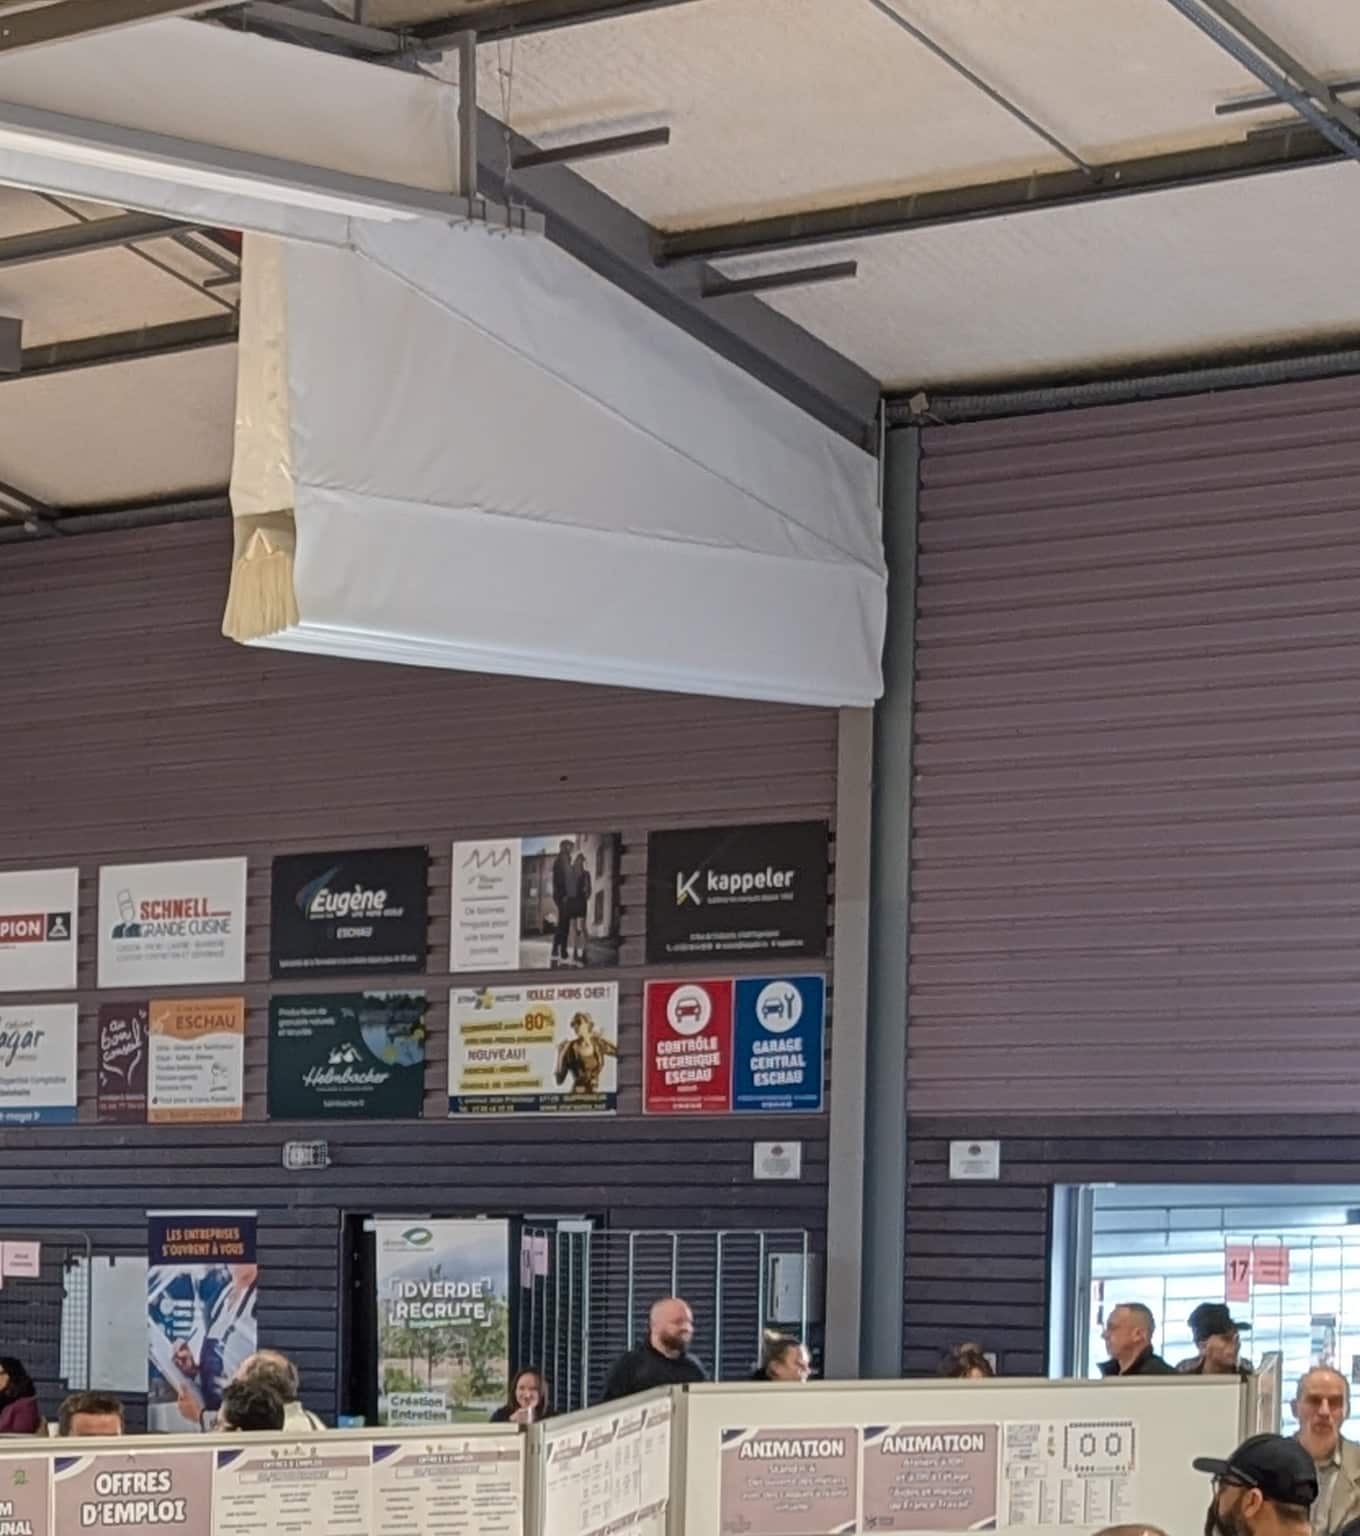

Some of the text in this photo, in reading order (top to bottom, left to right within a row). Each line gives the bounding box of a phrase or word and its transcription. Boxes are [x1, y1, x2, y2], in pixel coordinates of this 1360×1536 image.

[707, 866, 795, 894] kappeler
[140, 898, 209, 920] SCHNELL
[310, 884, 387, 917] Eugène
[188, 918, 232, 936] CUISINE
[175, 1015, 236, 1030] ESCHAU
[656, 1035, 718, 1055] CONTRÔLE
[752, 1036, 803, 1055] GARAGE
[655, 1052, 721, 1070] TECHNIQUE
[750, 1053, 806, 1071] CENTRAL
[665, 1069, 712, 1085] ESCHAU
[753, 1070, 803, 1087] ESCHAU
[165, 1226, 241, 1242] LES ENTREPRISES
[220, 1242, 245, 1255] VOUS
[1230, 1259, 1250, 1283] 17
[398, 1281, 484, 1299] IDVERDE
[396, 1301, 486, 1319] RECRUTE
[389, 1393, 443, 1408] Création
[390, 1409, 449, 1422] Entretien
[739, 1440, 844, 1459] ANIMATION
[882, 1434, 984, 1453] ANIMATION
[95, 1470, 172, 1495] OFFRES
[81, 1500, 186, 1526] D'EMPLOI
